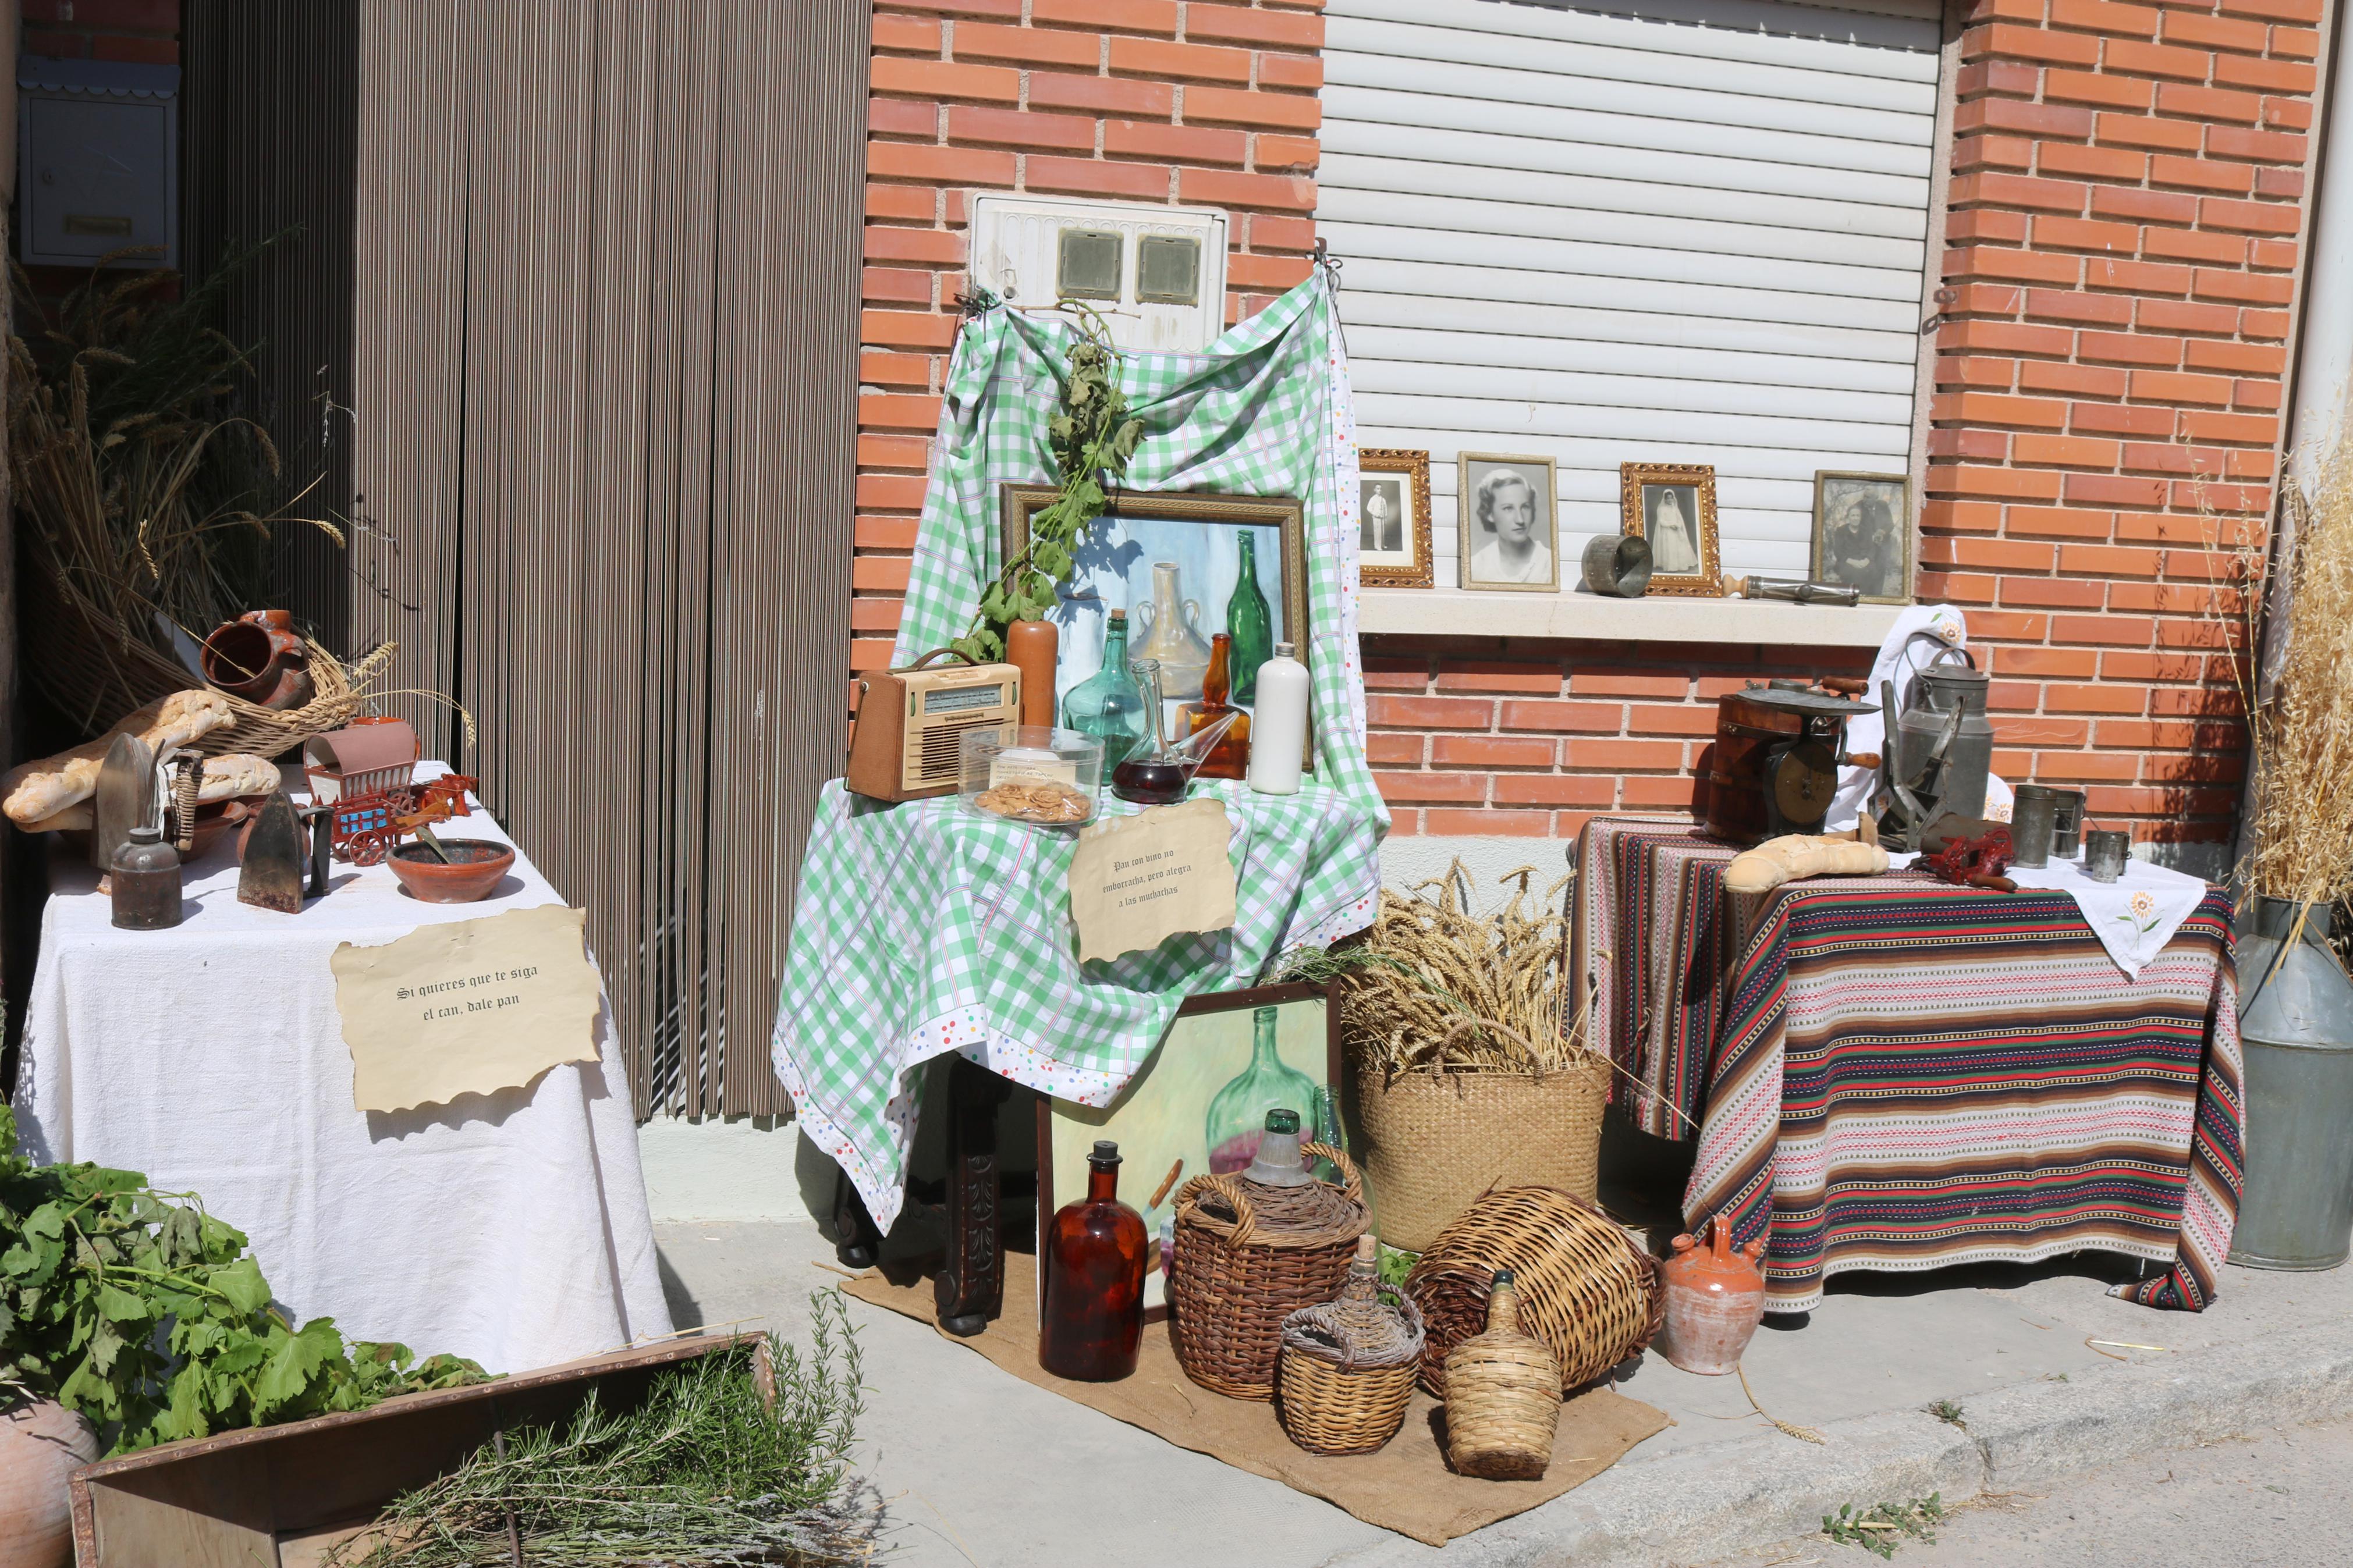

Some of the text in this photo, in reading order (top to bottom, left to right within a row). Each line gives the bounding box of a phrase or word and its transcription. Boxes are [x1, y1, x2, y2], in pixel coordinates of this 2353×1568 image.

[1113, 861, 1130, 873] Pan
[1131, 857, 1144, 866] con
[1145, 852, 1162, 862] vino
[1103, 865, 1192, 893] emborracha, pero alegra
[1118, 886, 1179, 908] a las muchachas
[396, 966, 538, 1001] Si quieres que te siga
[423, 994, 520, 1021] el can, dale pan
